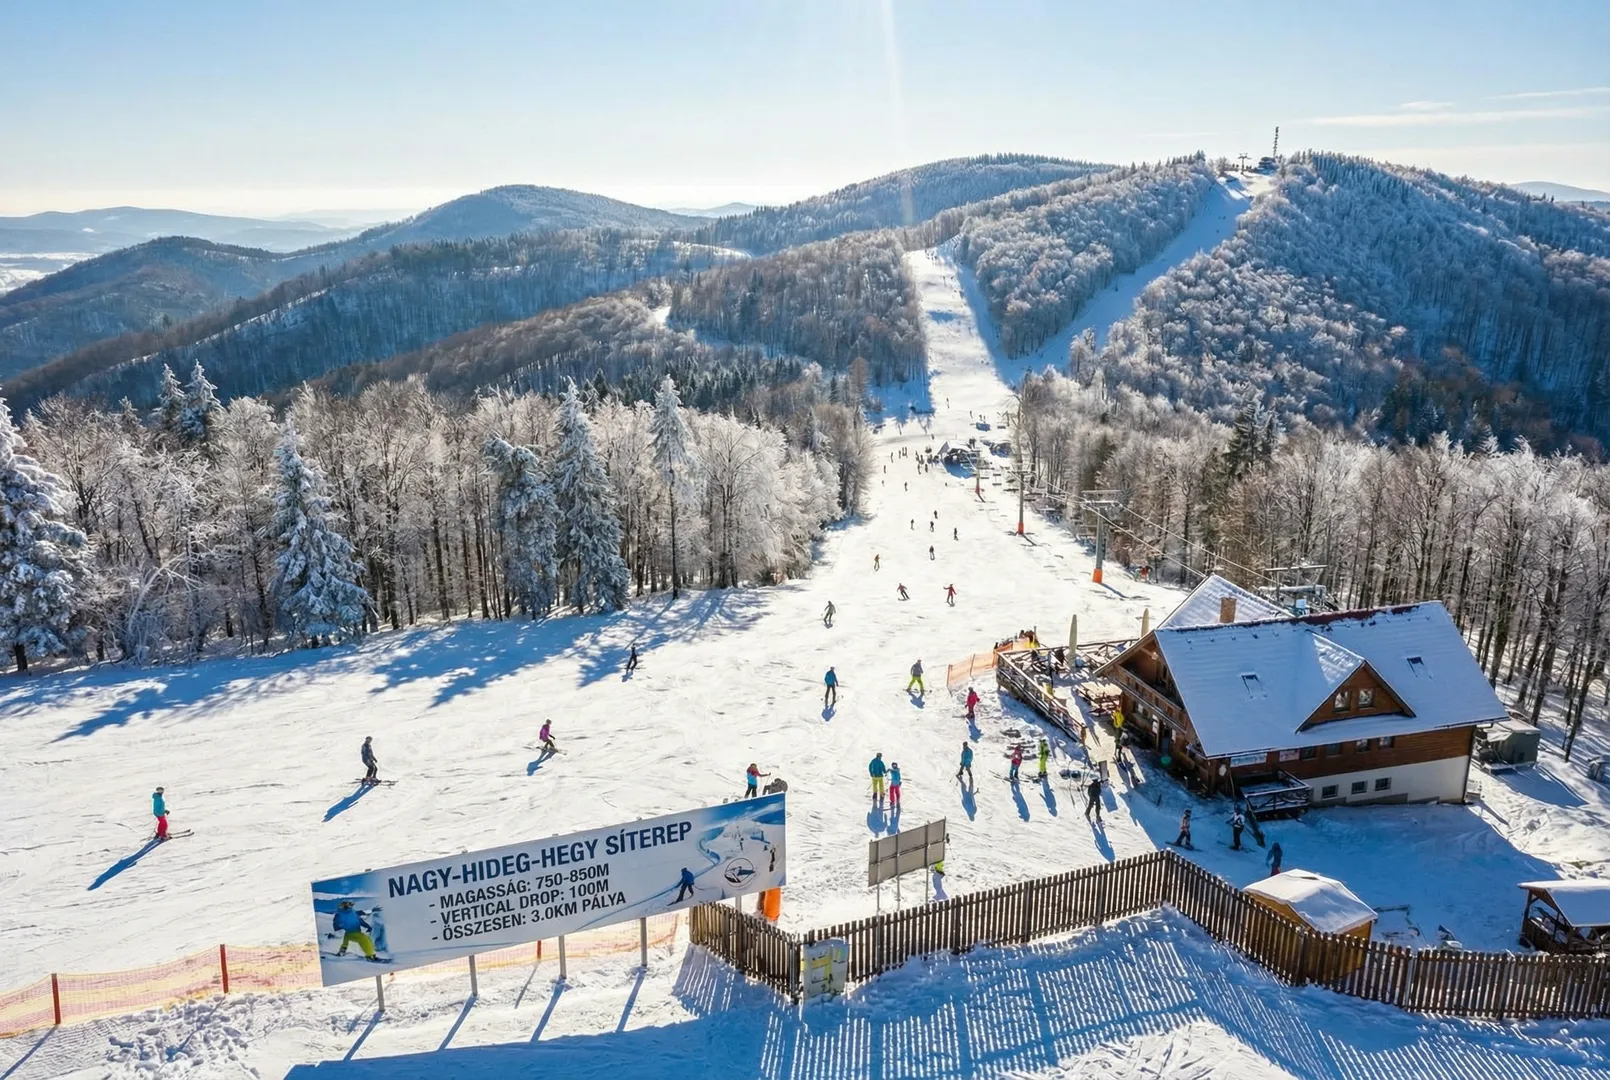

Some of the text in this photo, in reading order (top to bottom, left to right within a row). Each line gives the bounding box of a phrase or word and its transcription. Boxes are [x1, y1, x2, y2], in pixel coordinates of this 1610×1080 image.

[388, 821, 693, 899] NAGY-HIDEG-HEGY SÍTEREP
[440, 879, 531, 909] MAGASSÁG:
[536, 863, 610, 890] 750-850M
[440, 899, 516, 925] VERTICAL
[519, 889, 565, 910] DROP:
[569, 879, 609, 899] 100M
[443, 913, 527, 942] ÖSSZESEN:
[531, 901, 578, 923] 3.0KM
[582, 892, 627, 913] PÁLYA
